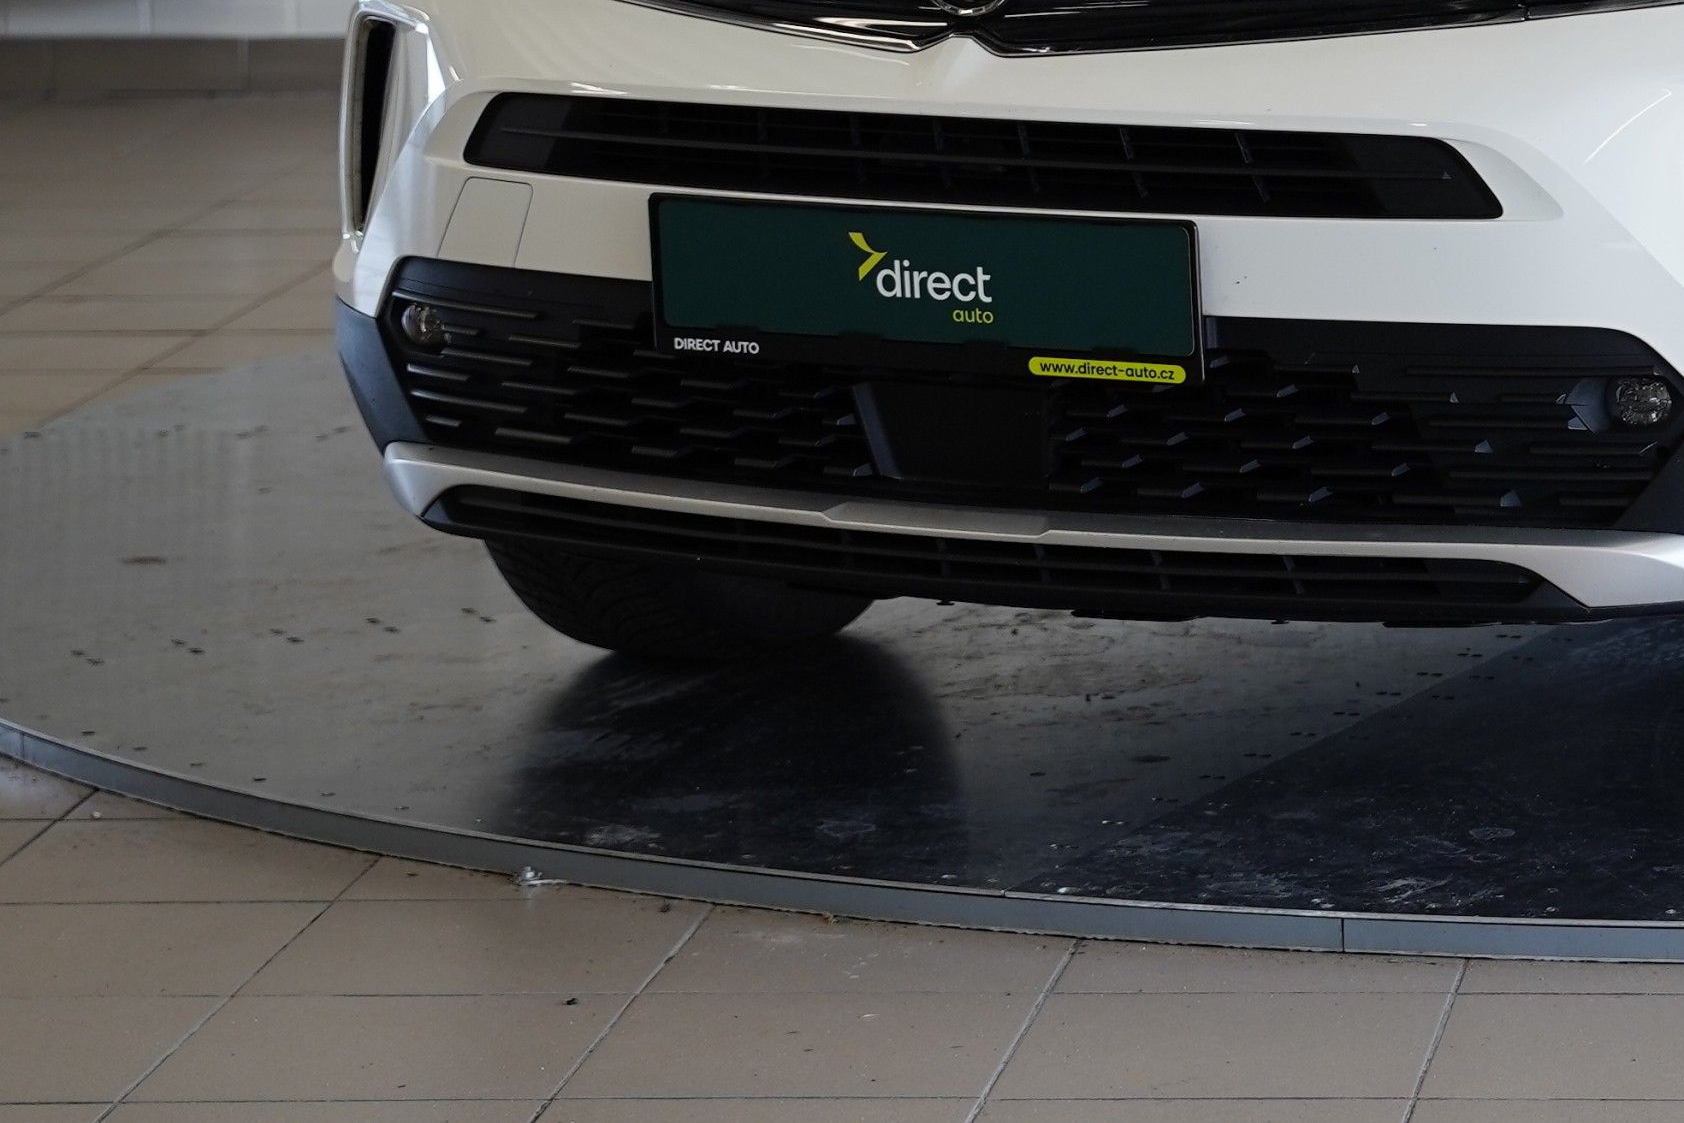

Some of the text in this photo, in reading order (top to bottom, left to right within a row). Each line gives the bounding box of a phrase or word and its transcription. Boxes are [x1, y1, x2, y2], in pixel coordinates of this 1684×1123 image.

[877, 260, 993, 303] direct
[952, 306, 994, 324] auto
[674, 337, 760, 354] DIRECT AUTO
[1039, 362, 1175, 380] www.direct-auto.cz
